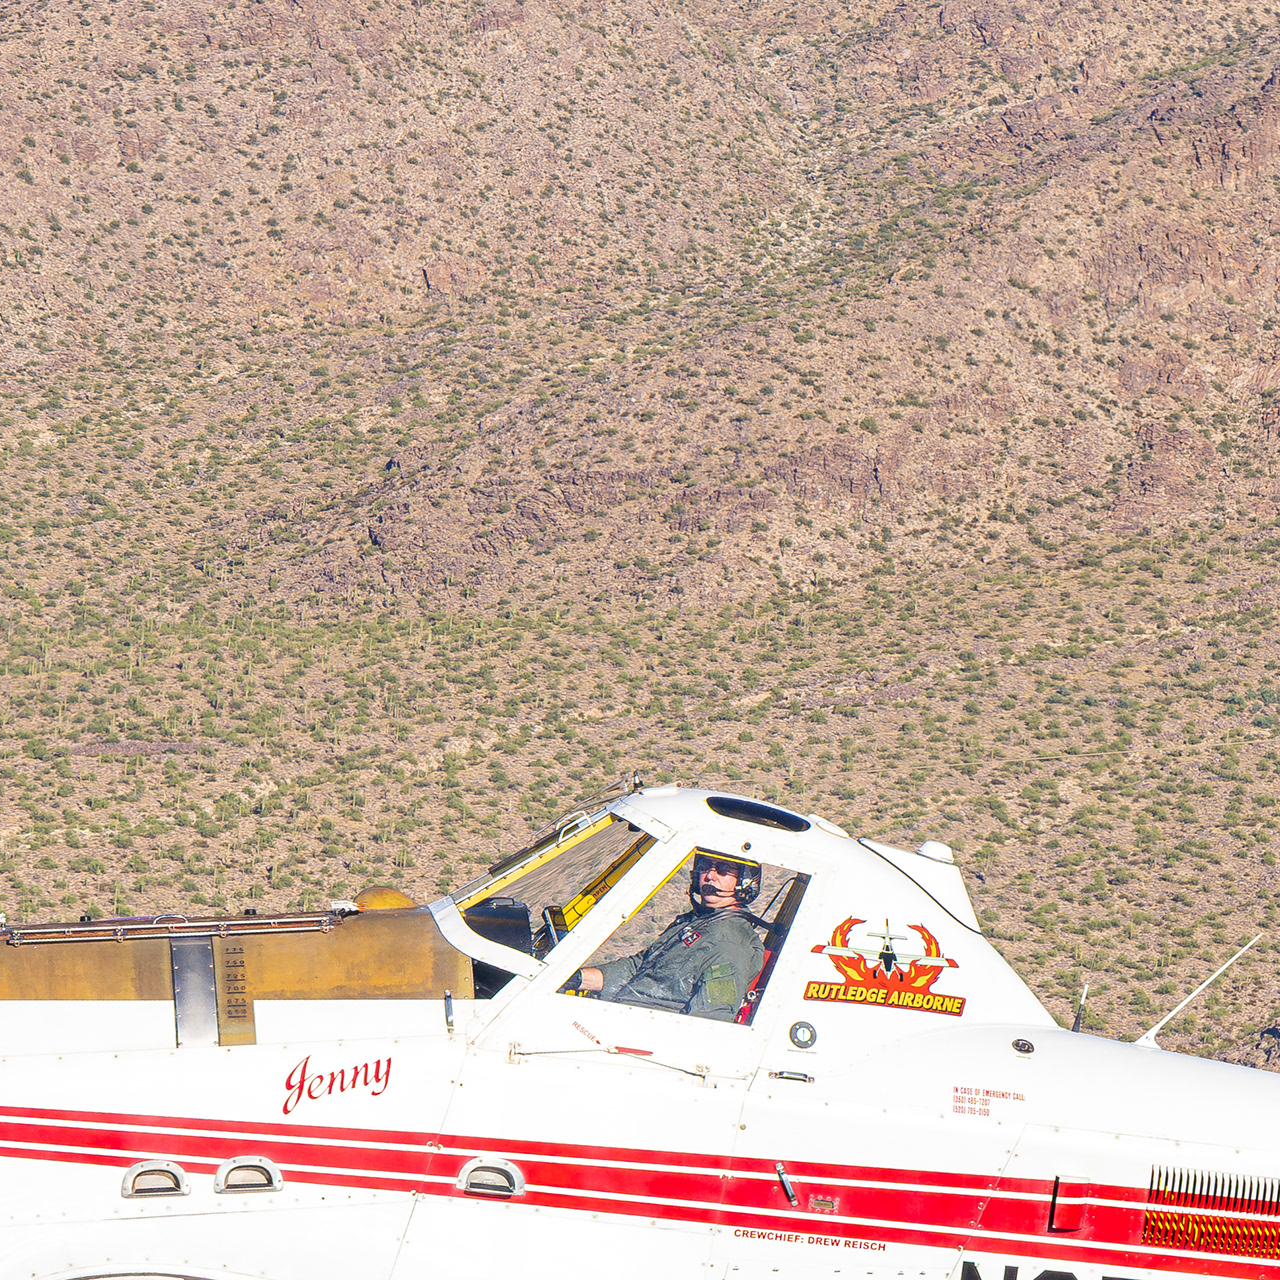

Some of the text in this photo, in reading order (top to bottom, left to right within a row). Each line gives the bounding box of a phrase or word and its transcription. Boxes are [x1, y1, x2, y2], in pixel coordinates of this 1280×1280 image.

[806, 982, 964, 1014] RUTLEDGE AIRBORNE
[572, 1020, 597, 1042] RESCUE
[282, 1054, 392, 1115] Jenny
[960, 1087, 973, 1096] CASE
[982, 1089, 1012, 1100] EMERGENCY
[734, 1228, 887, 1252] CREWCHIEF: DREW REISCH
